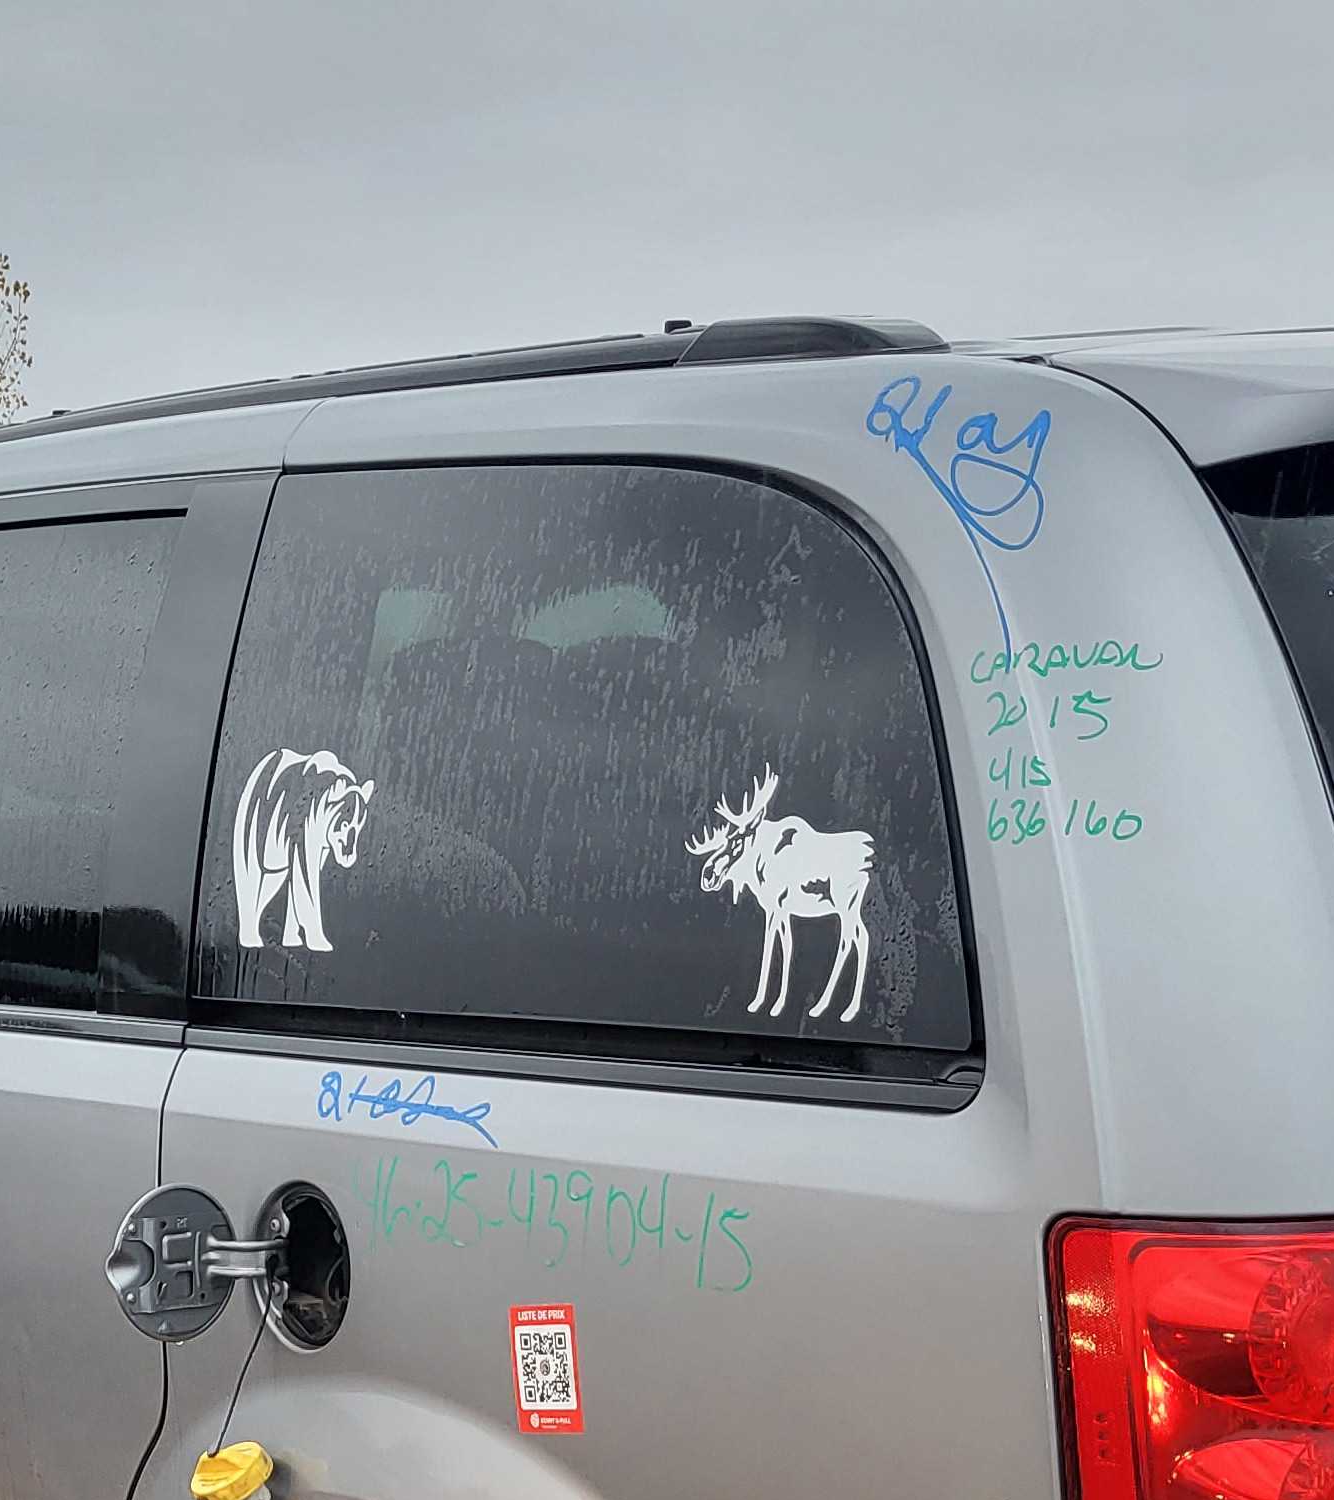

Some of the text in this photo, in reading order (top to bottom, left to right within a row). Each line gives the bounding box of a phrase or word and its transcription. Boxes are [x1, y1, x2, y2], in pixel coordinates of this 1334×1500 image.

[517, 1309, 566, 1321] LISTE DE PRIX
